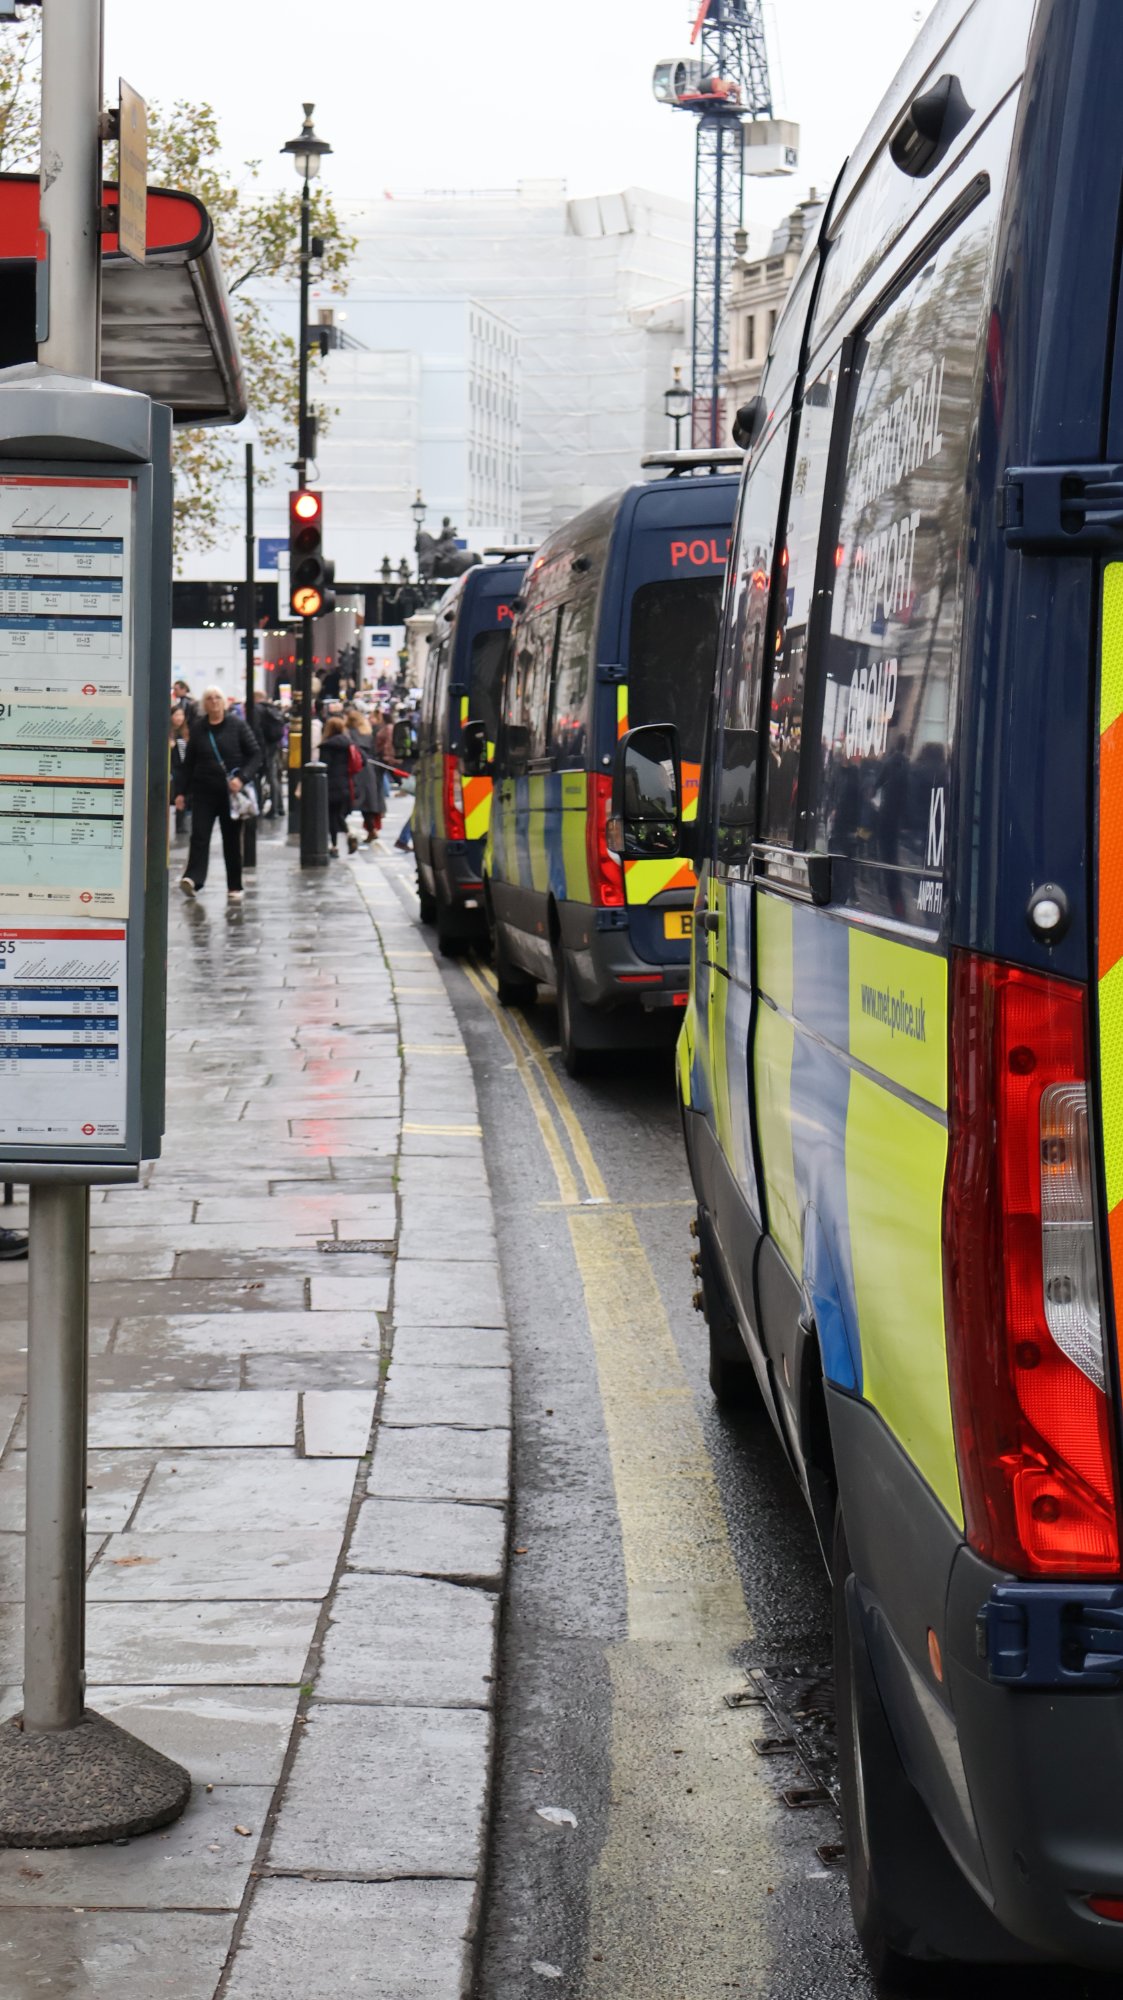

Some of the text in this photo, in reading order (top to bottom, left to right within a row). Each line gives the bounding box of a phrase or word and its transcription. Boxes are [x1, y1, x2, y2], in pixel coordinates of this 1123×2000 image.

[850, 509, 921, 631] SUPPORT
[846, 658, 898, 759] GROUP
[916, 880, 934, 912] ANPR
[861, 984, 926, 1043] www.met.police.uk
